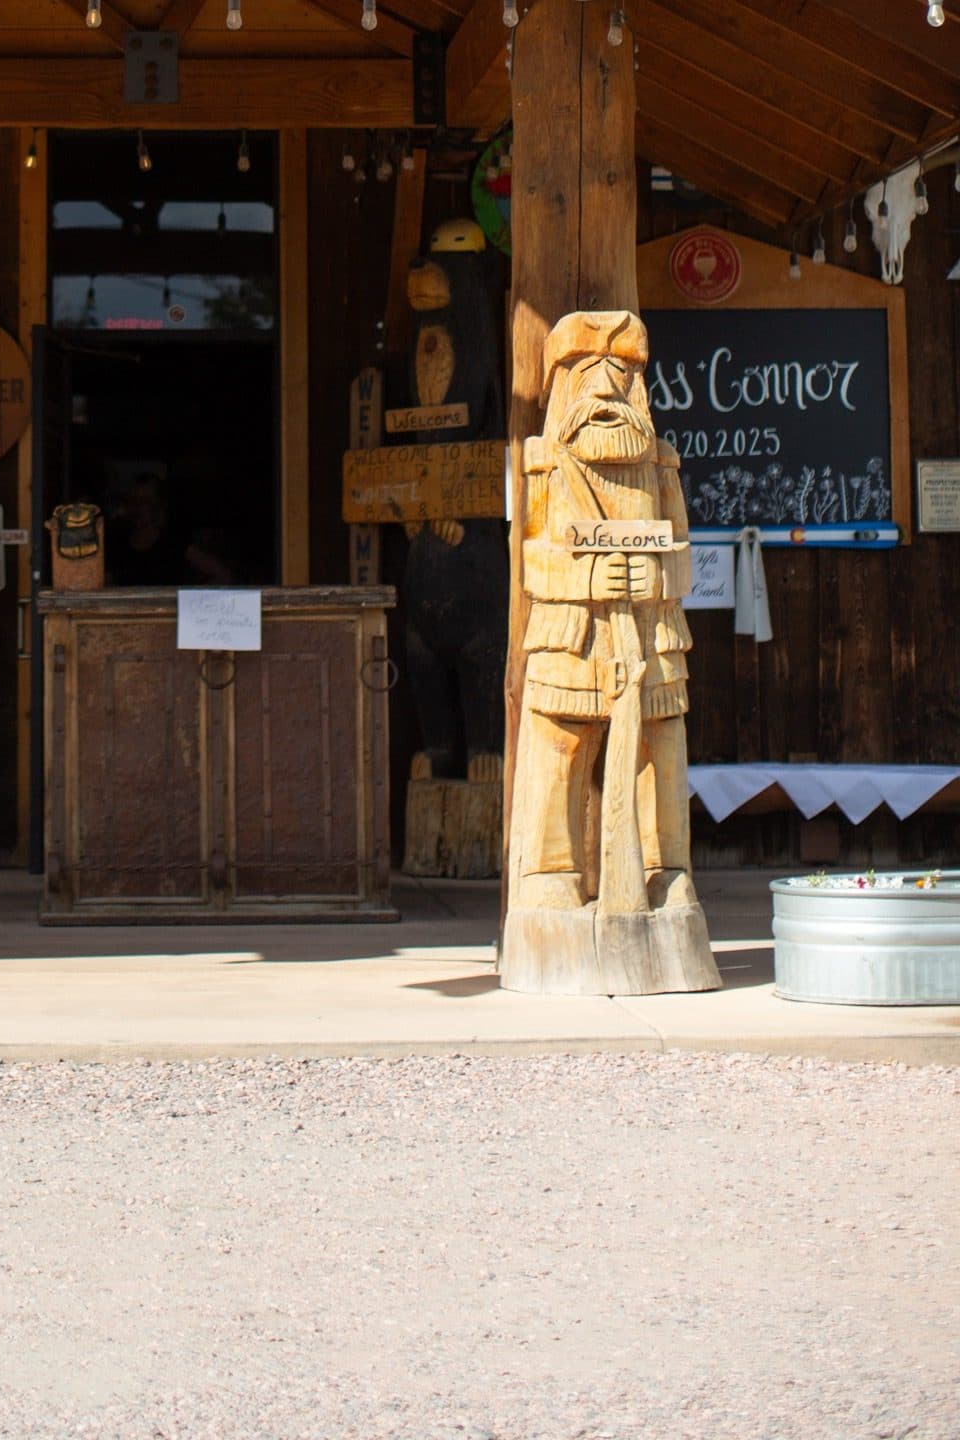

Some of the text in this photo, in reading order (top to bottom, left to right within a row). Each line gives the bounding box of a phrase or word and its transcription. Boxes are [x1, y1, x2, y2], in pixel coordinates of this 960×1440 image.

[648, 360, 694, 411] ss
[709, 347, 859, 413] Connor
[392, 409, 461, 429] WELCOME
[440, 445, 461, 462] TO
[471, 443, 497, 459] THE
[571, 523, 669, 549] WELCOME
